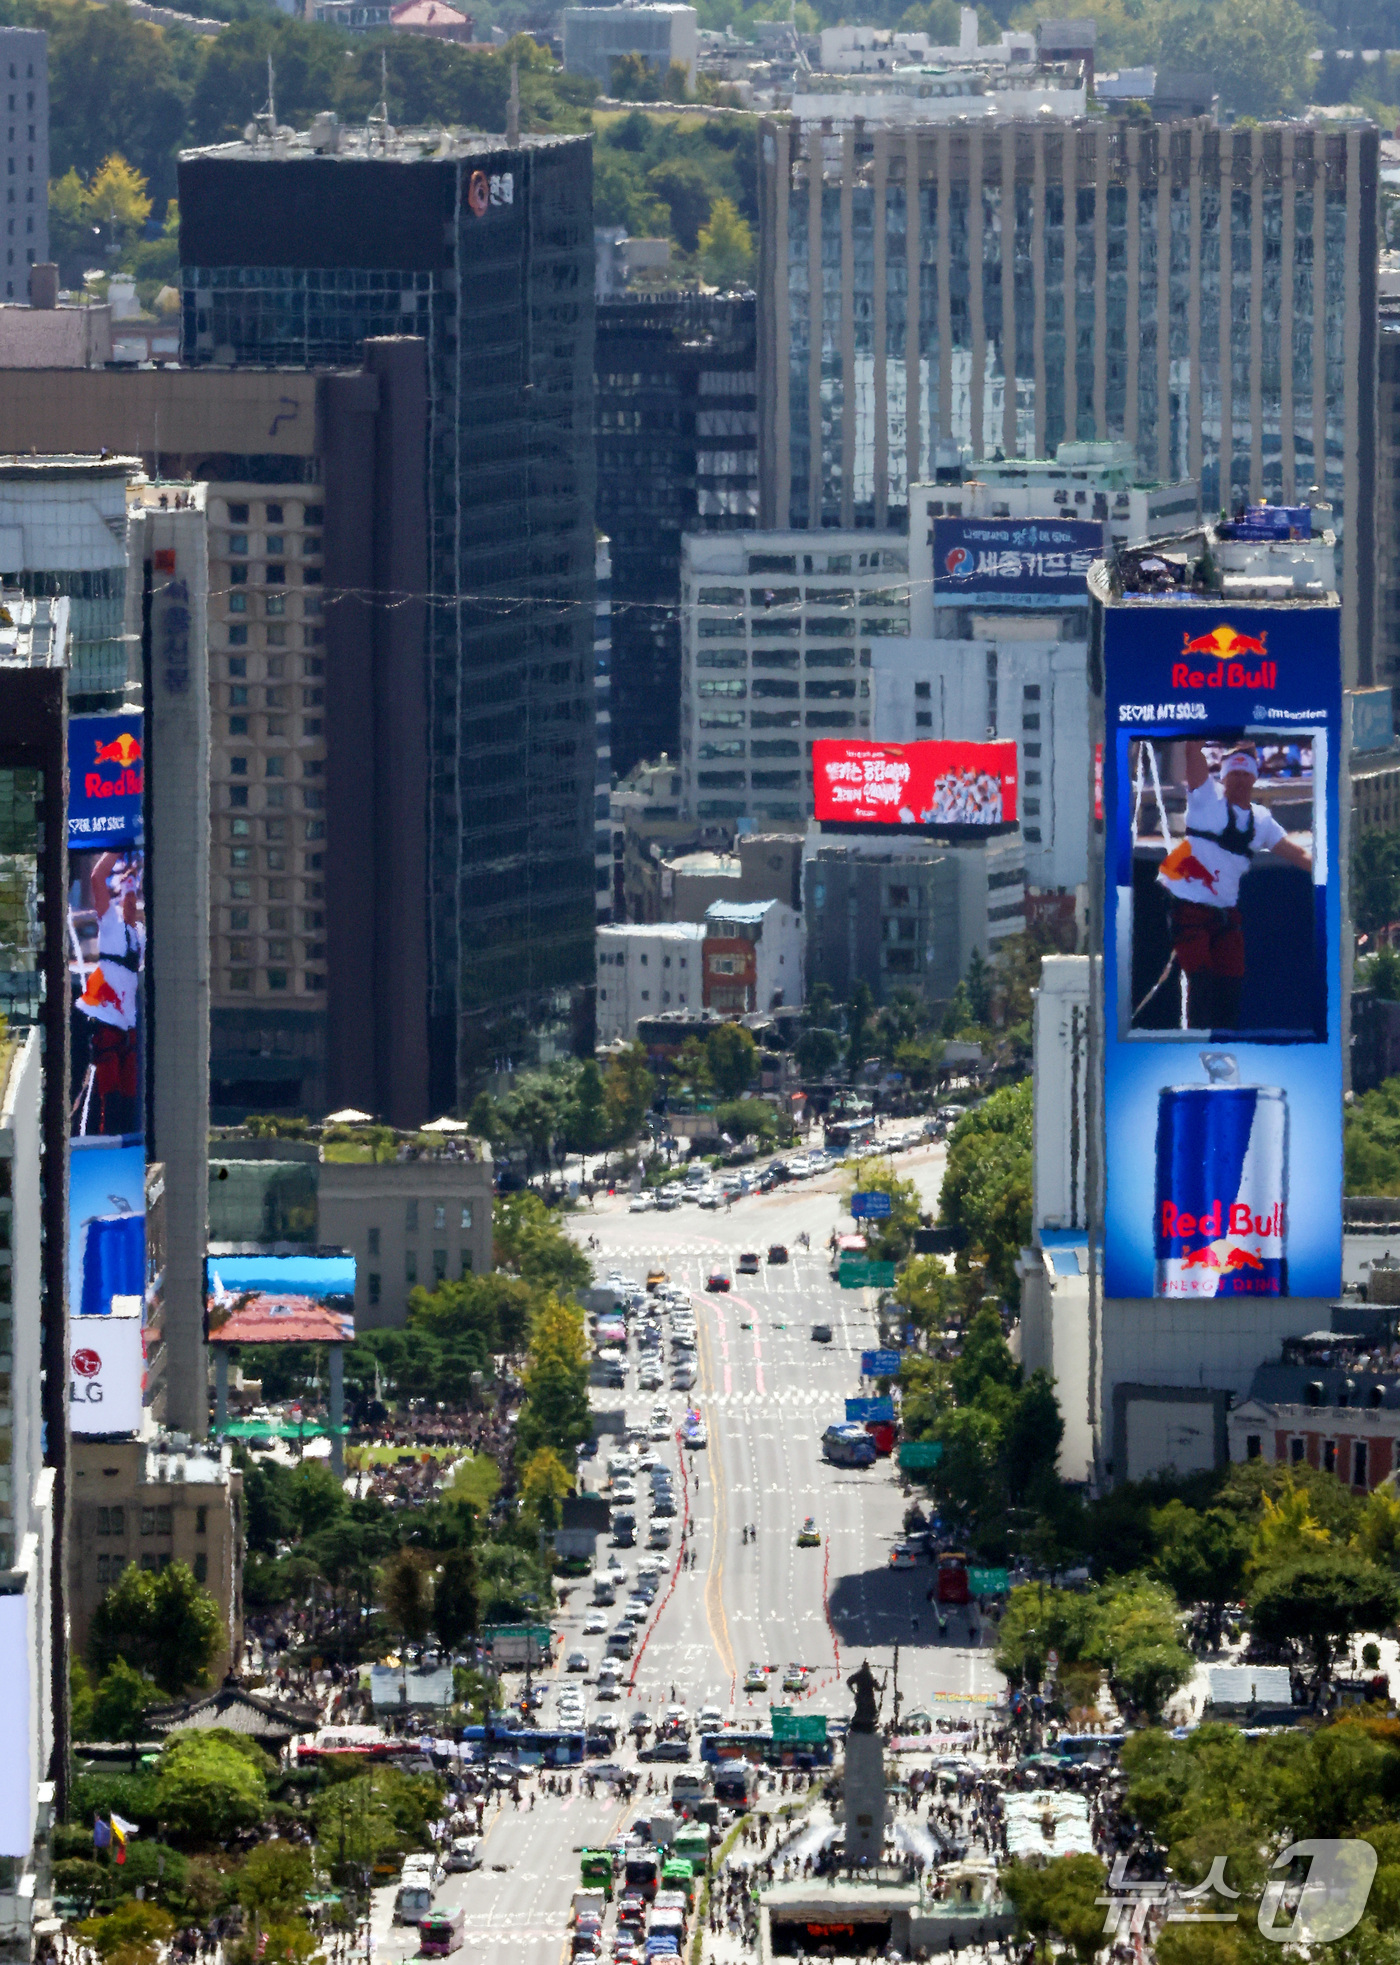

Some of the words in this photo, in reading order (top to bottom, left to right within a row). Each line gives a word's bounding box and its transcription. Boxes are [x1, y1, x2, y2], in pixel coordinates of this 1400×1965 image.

[1172, 662, 1224, 688] Red
[1226, 662, 1277, 689] Bull
[85, 769, 125, 798] Red
[1162, 1199, 1222, 1237] Red
[1229, 1202, 1284, 1237] Bull
[1161, 1277, 1225, 1292] ENERGY
[69, 1382, 103, 1403] LG
